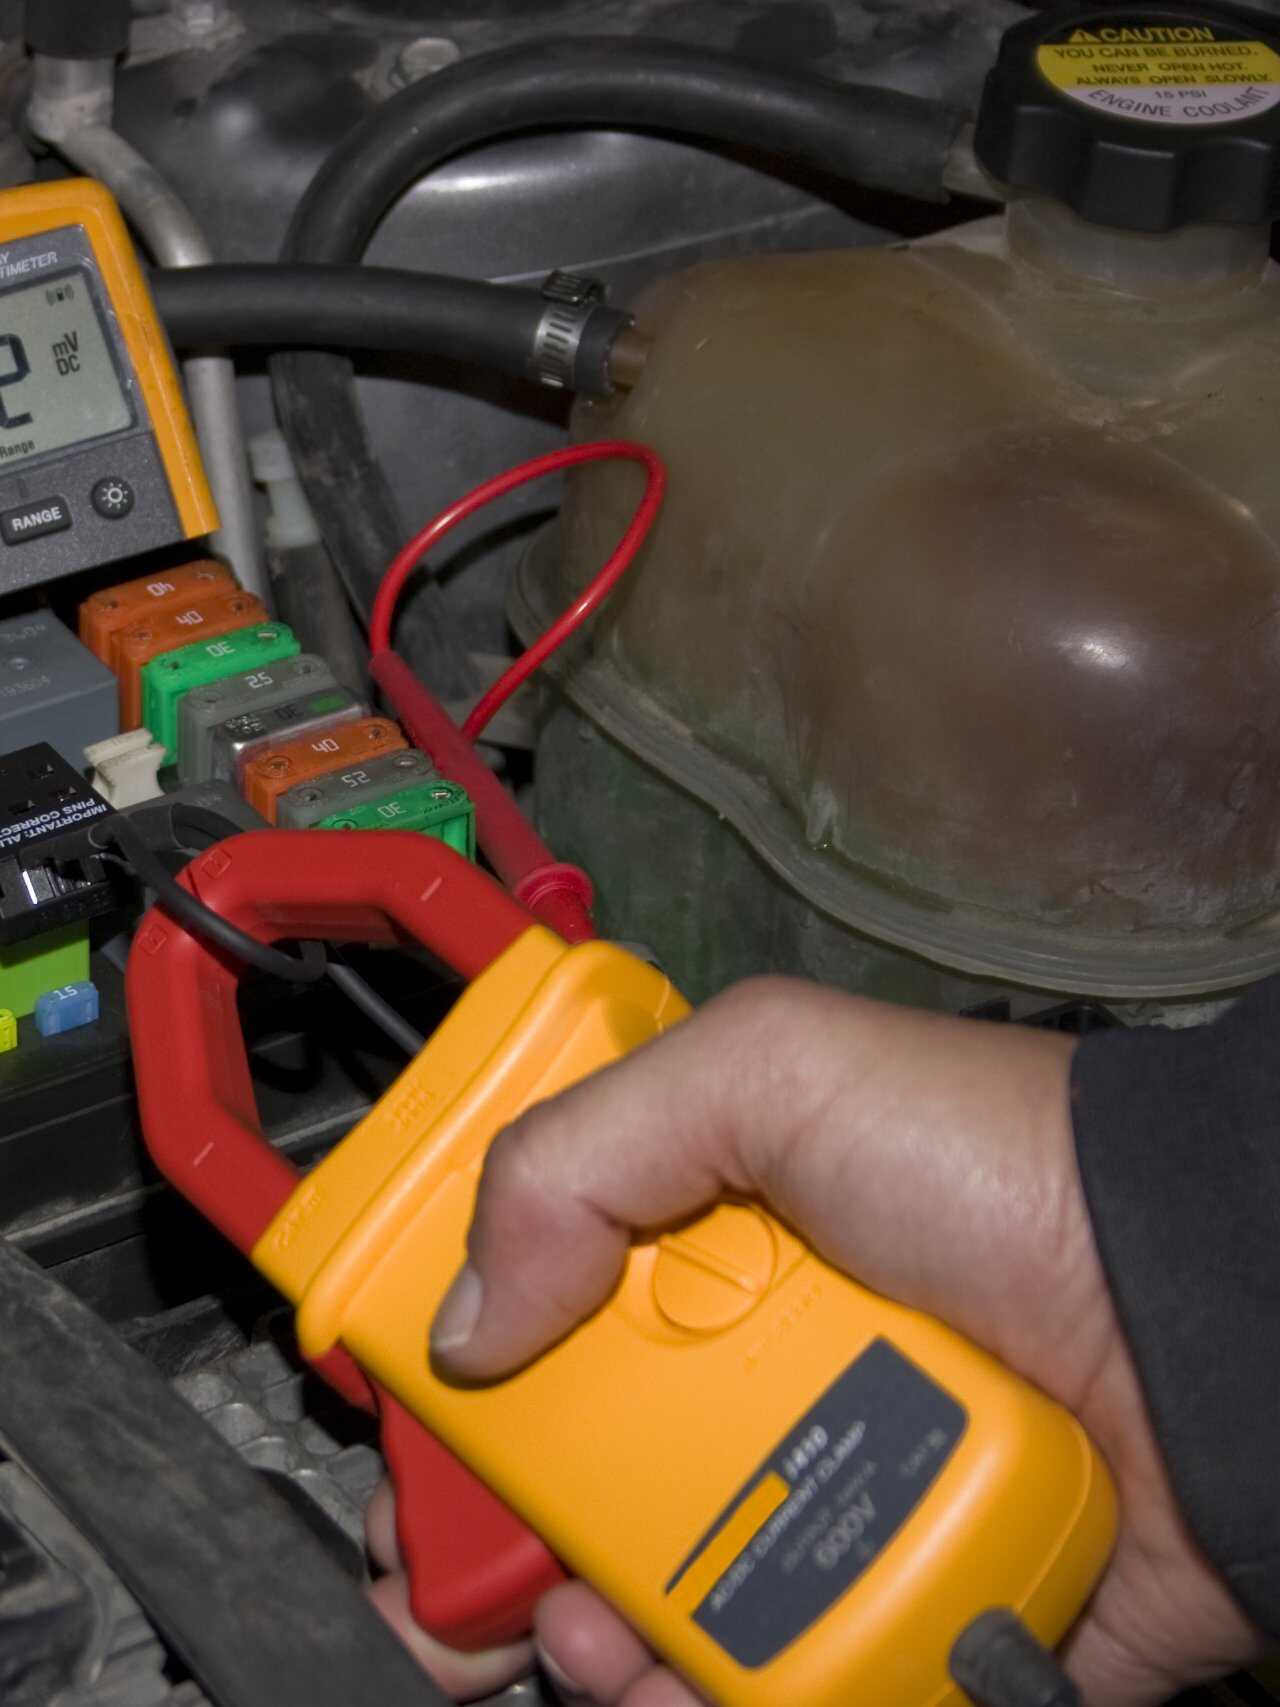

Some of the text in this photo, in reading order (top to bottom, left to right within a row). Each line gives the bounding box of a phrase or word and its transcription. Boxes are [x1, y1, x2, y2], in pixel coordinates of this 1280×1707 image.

[1100, 27, 1214, 41] CAUTION
[1054, 46, 1259, 59] YOU CAN BE BURNED.
[1092, 63, 1148, 73] NEVER
[1158, 62, 1205, 72] OPEN
[1077, 76, 1140, 86] ALWAYS
[1149, 75, 1196, 85] OPEN
[1088, 86, 1269, 117] ENGINE COOLANT
[1179, 90, 1207, 99] PSI
[52, 331, 79, 358] mV
[56, 354, 81, 376] DC
[0, 439, 36, 460] Range
[11, 506, 63, 532] RANGE
[146, 581, 176, 597] 40
[175, 610, 205, 625] 40
[244, 672, 274, 689] 25
[311, 737, 341, 754] 40
[62, 798, 96, 816] PINS
[22, 803, 107, 839] IMPORTANT:
[53, 985, 78, 1001] 15
